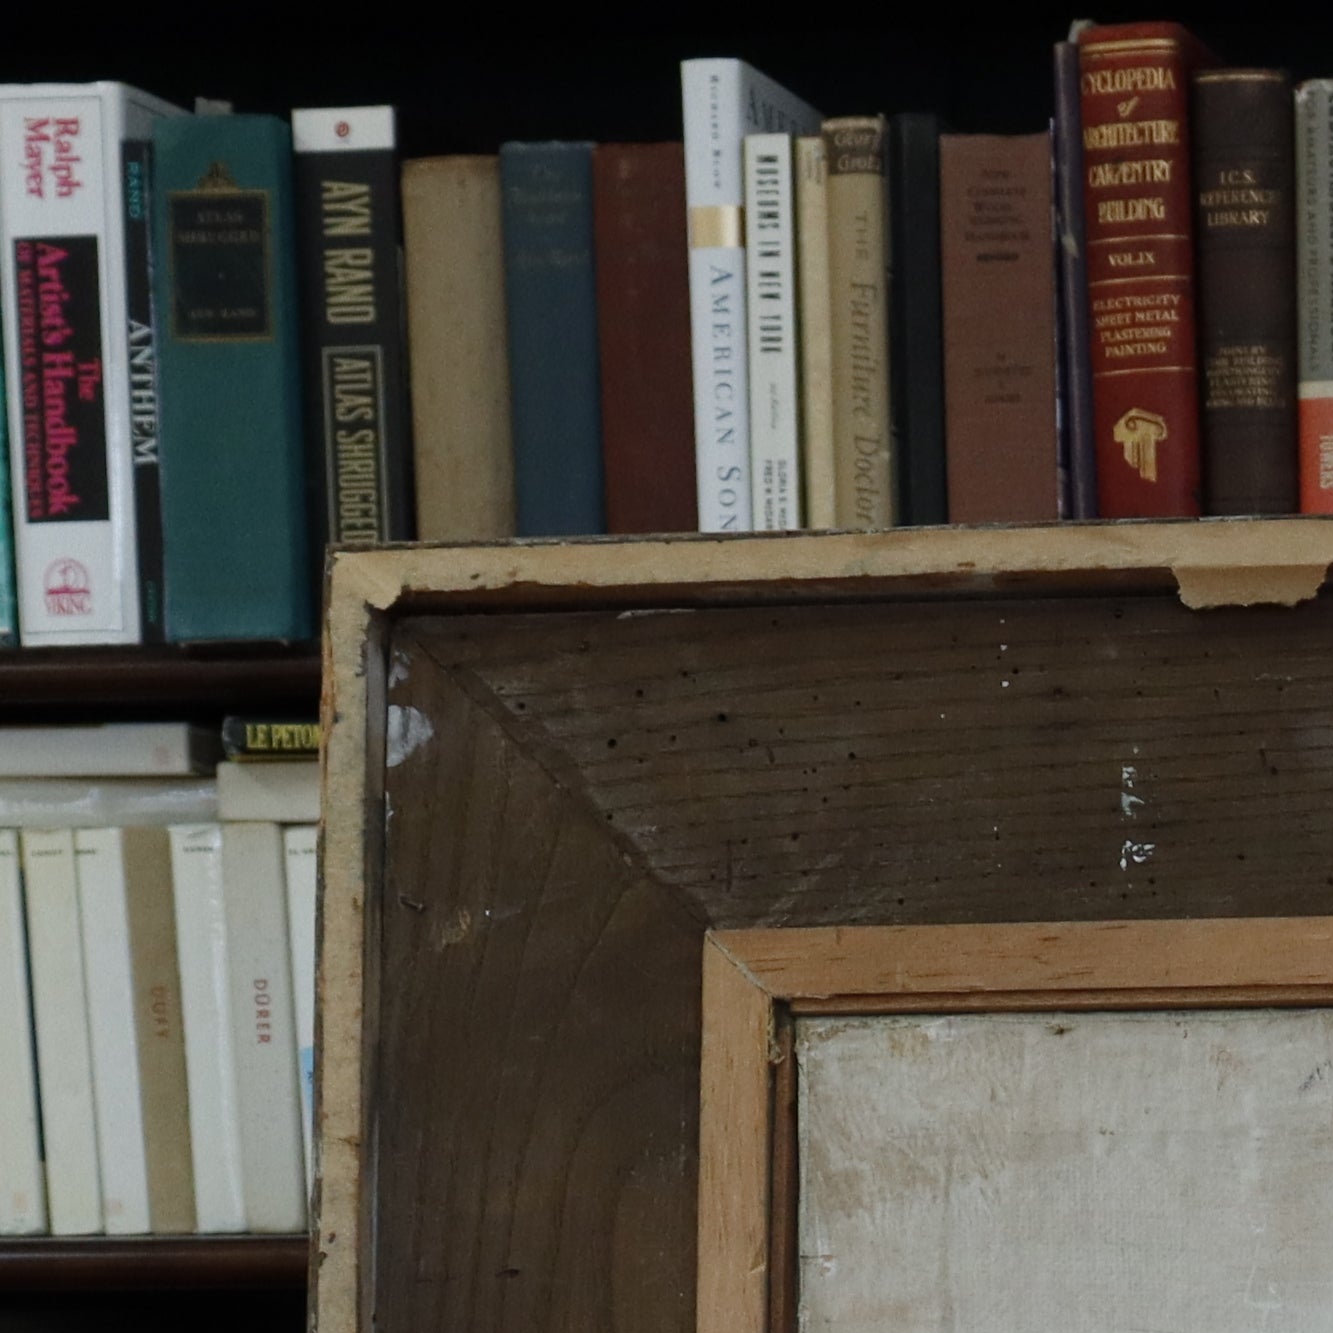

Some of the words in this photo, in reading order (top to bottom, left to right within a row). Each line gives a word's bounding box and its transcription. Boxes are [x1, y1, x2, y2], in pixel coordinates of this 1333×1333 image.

[22, 117, 50, 198] Mayer
[56, 117, 82, 197] Ralph
[322, 181, 371, 236] AYN
[1098, 196, 1166, 223] BUILDING
[1207, 211, 1269, 227] LIBRARY
[35, 242, 73, 346] Artist's
[324, 248, 376, 325] RAND
[1134, 310, 1180, 325] METAL
[78, 357, 99, 402] The
[709, 264, 736, 446] AMERICAN
[1105, 342, 1167, 357] PAINTING
[126, 318, 159, 463] ANTHEM
[334, 357, 376, 421] ATLAS
[41, 351, 80, 516] Handbook
[337, 428, 380, 545] SHRUGGED
